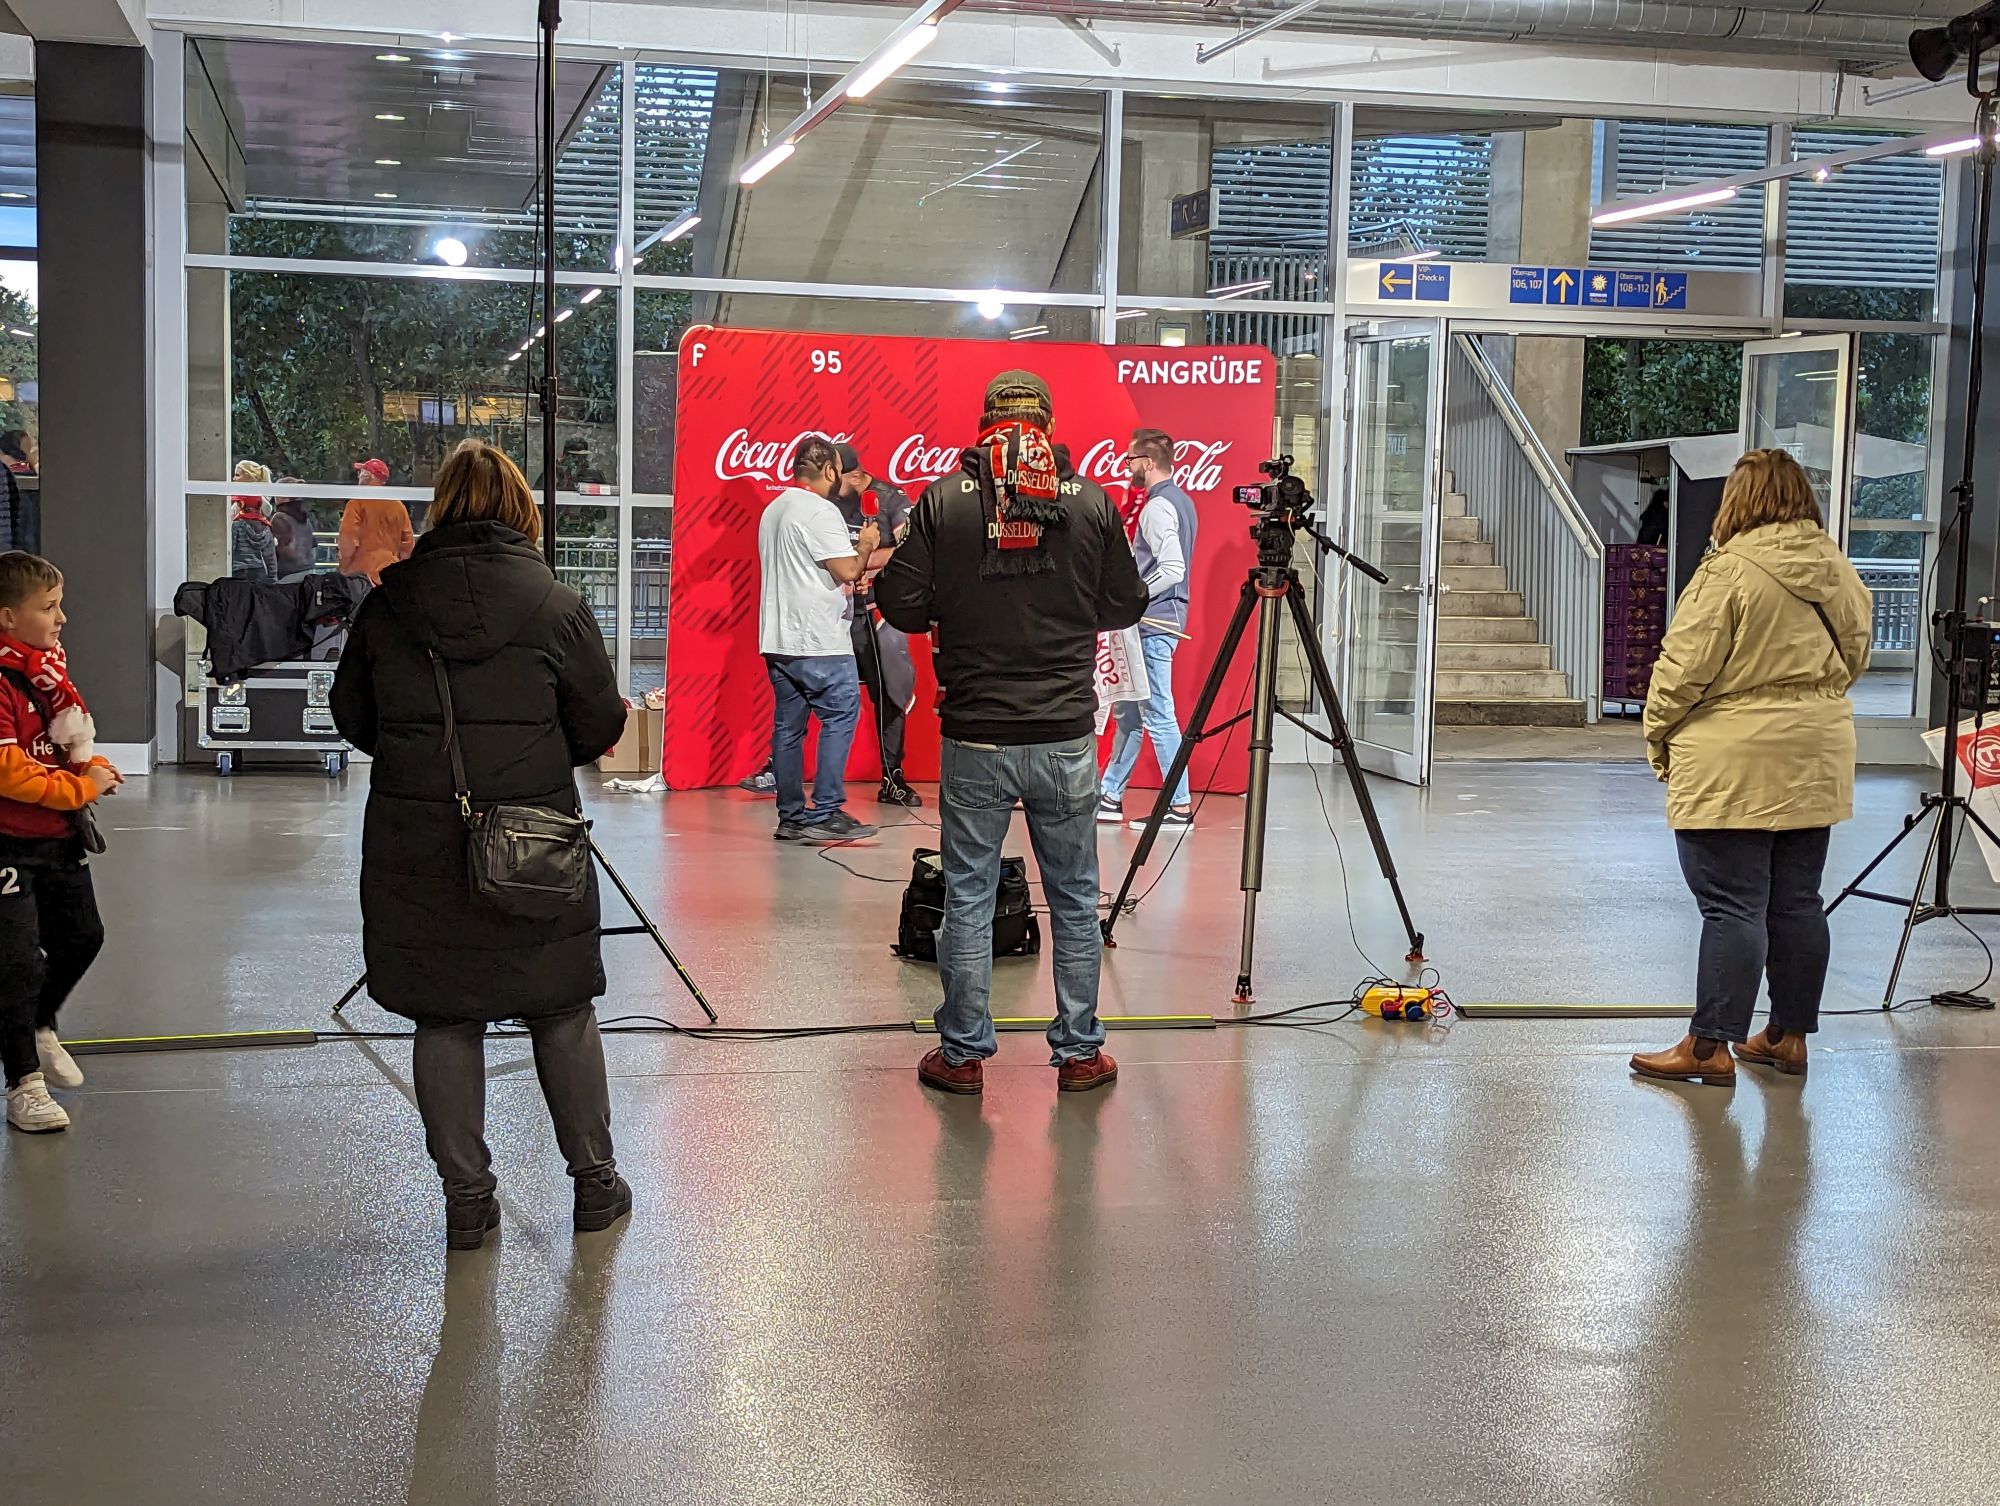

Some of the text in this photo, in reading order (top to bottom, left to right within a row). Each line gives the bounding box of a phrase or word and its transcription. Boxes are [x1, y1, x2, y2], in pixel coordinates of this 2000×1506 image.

[1512, 279, 1542, 290] 106, 107
[692, 343, 707, 367] F
[810, 349, 842, 374] 95
